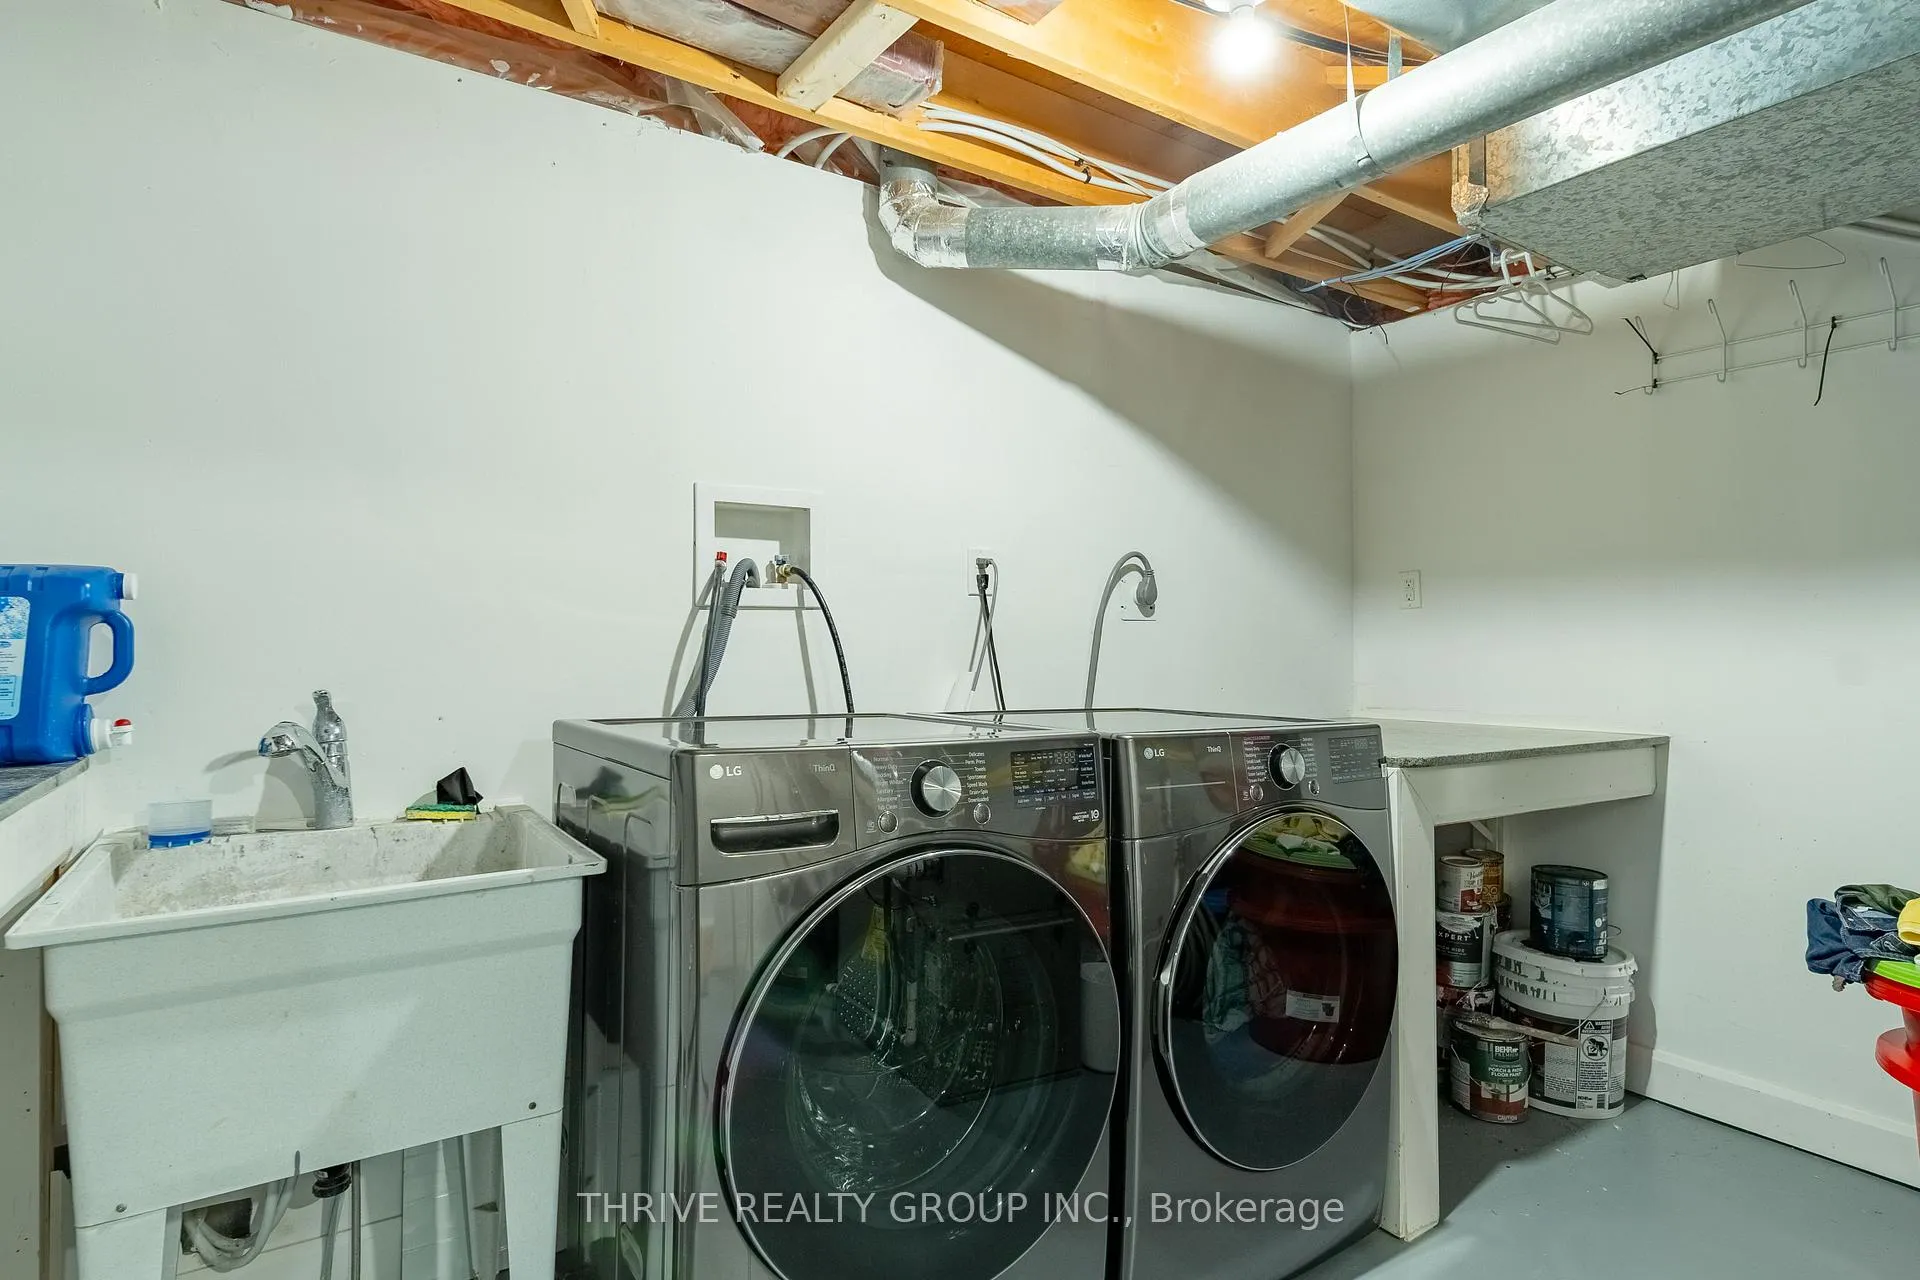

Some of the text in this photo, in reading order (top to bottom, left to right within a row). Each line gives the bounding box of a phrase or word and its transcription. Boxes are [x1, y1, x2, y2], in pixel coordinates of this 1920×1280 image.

[1154, 748, 1165, 757] LG
[1206, 745, 1222, 753] ThinQ
[726, 766, 742, 777] LG
[813, 764, 836, 773] ThinQ
[1438, 931, 1470, 942] XPERT
[1494, 1045, 1513, 1053] BEHR
